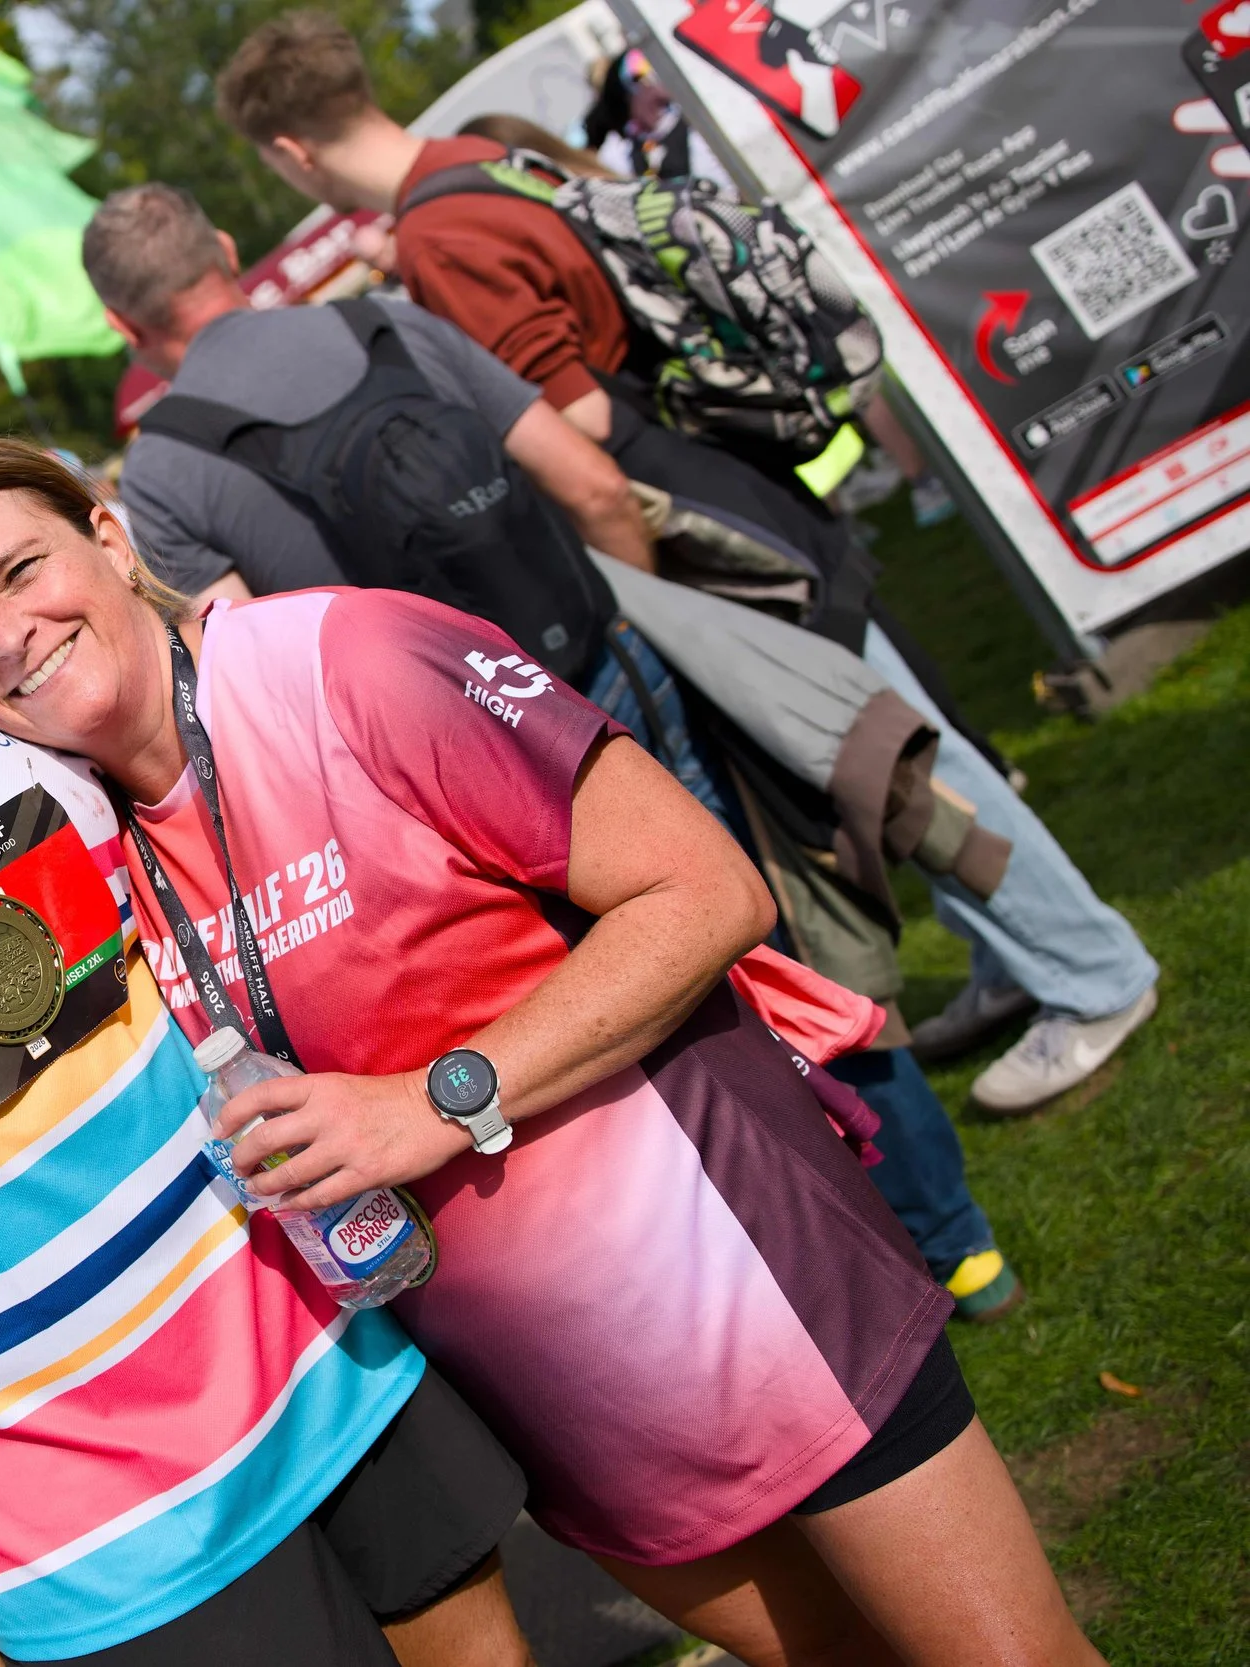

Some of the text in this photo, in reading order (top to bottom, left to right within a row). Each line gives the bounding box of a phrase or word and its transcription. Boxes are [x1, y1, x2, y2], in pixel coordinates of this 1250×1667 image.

[178, 680, 196, 723] 2026
[464, 680, 524, 728] HIGH
[286, 838, 346, 905] '26
[257, 889, 355, 967] CAERDYDD
[86, 953, 104, 974] 2XL
[239, 908, 275, 1018] CARDIFF HALF
[200, 971, 226, 1015] 2026
[29, 1037, 46, 1055] 2026
[448, 1068, 469, 1088] 31
[457, 1079, 478, 1099] 13
[337, 1189, 392, 1245] BRECON
[347, 1204, 400, 1257] CARREG
[376, 1234, 393, 1249] STILL
